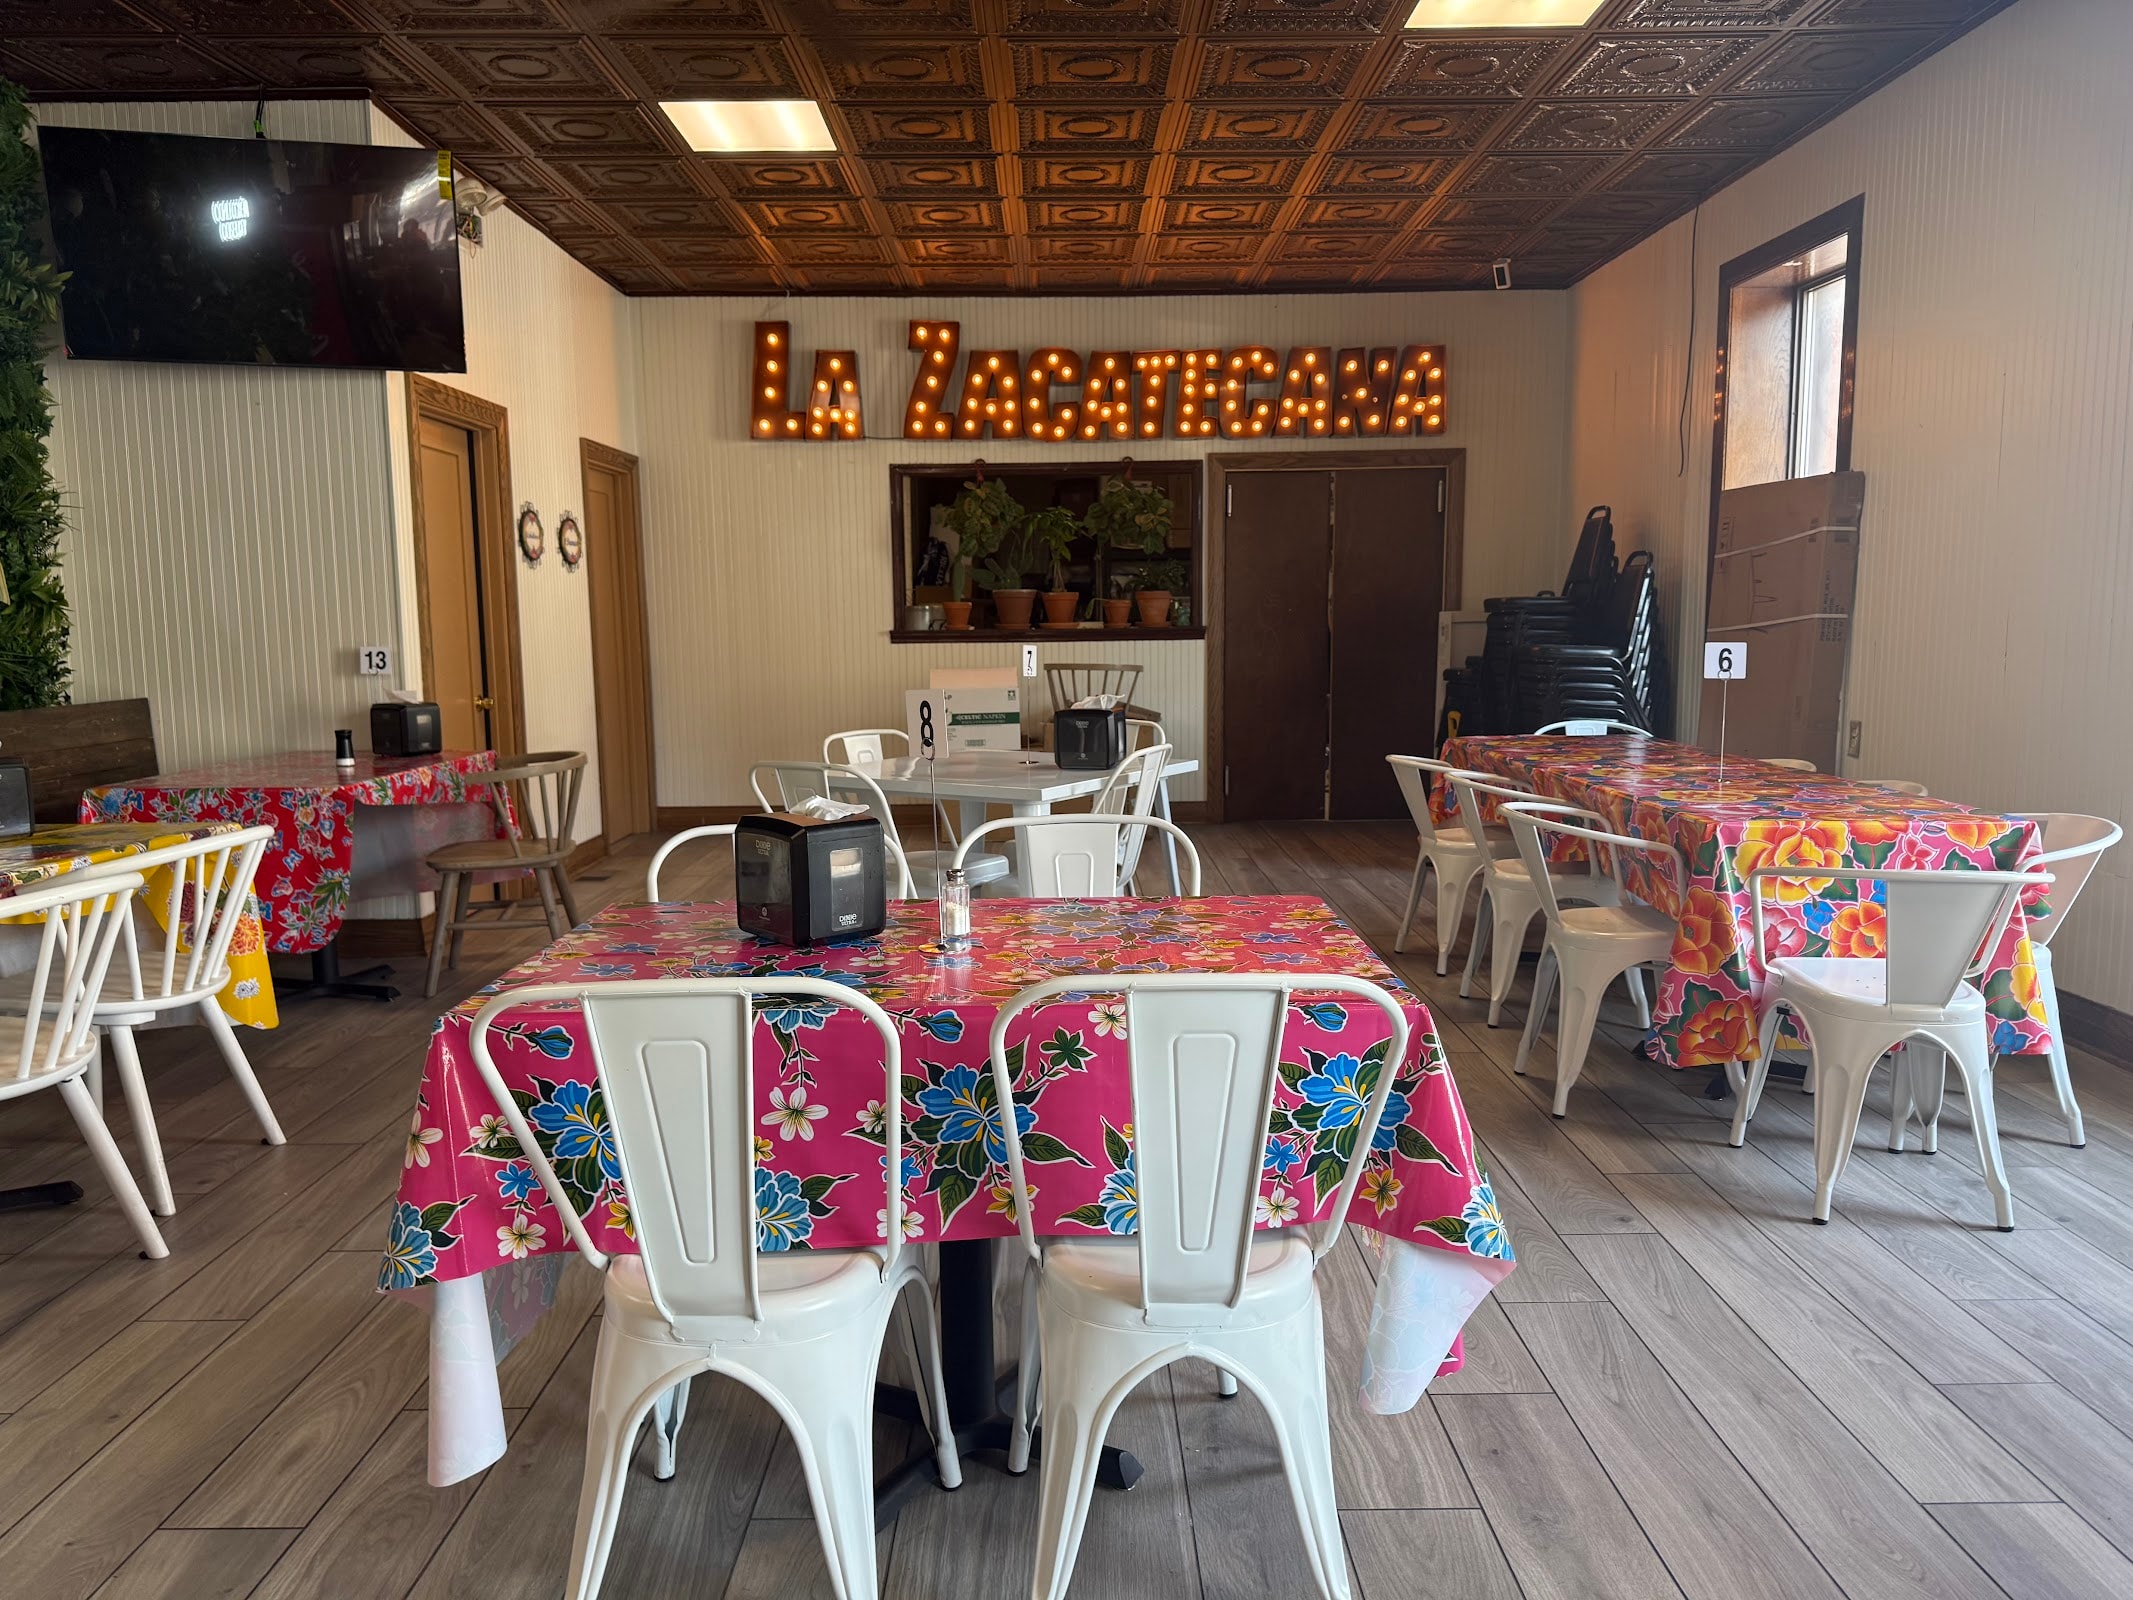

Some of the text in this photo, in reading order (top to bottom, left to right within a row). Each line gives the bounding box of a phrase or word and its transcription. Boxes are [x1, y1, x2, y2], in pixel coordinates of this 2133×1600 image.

[903, 320, 1448, 442] ZACATECANA
[365, 651, 386, 670] 13
[1718, 648, 1732, 672] 6
[920, 700, 934, 746] 8
